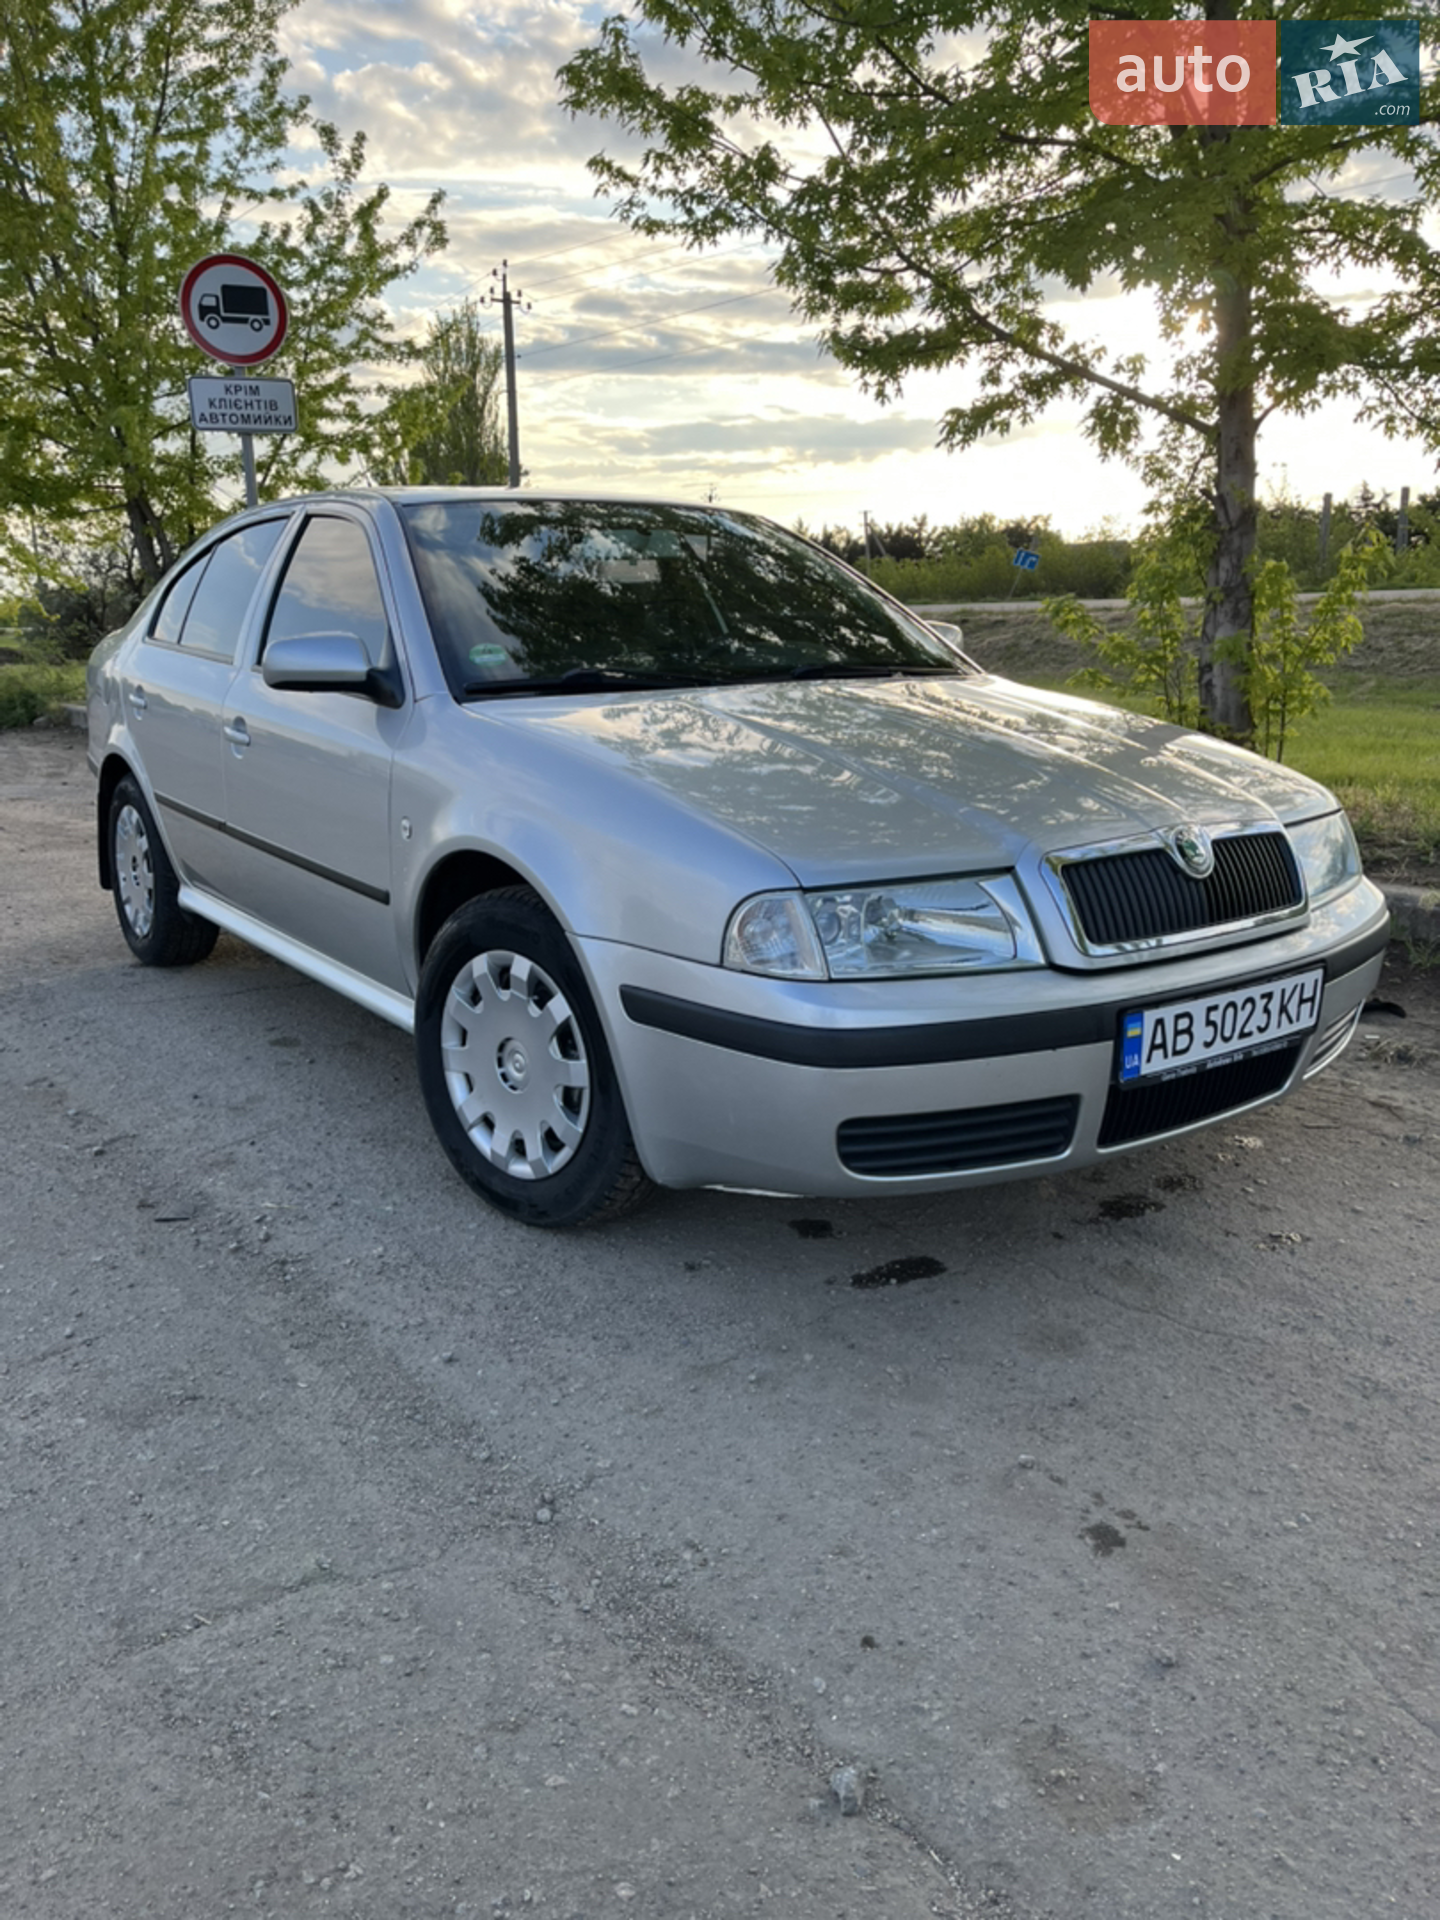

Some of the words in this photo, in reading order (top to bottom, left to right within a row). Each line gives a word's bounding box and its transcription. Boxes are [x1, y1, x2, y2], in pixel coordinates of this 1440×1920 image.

[224, 384, 261, 397] КРІМ
[208, 397, 279, 411] КЛІЄНТІВ
[199, 411, 293, 426] АВТОМИЙКИ
[1203, 991, 1274, 1049] 5023
[1125, 1054, 1140, 1069] UA
